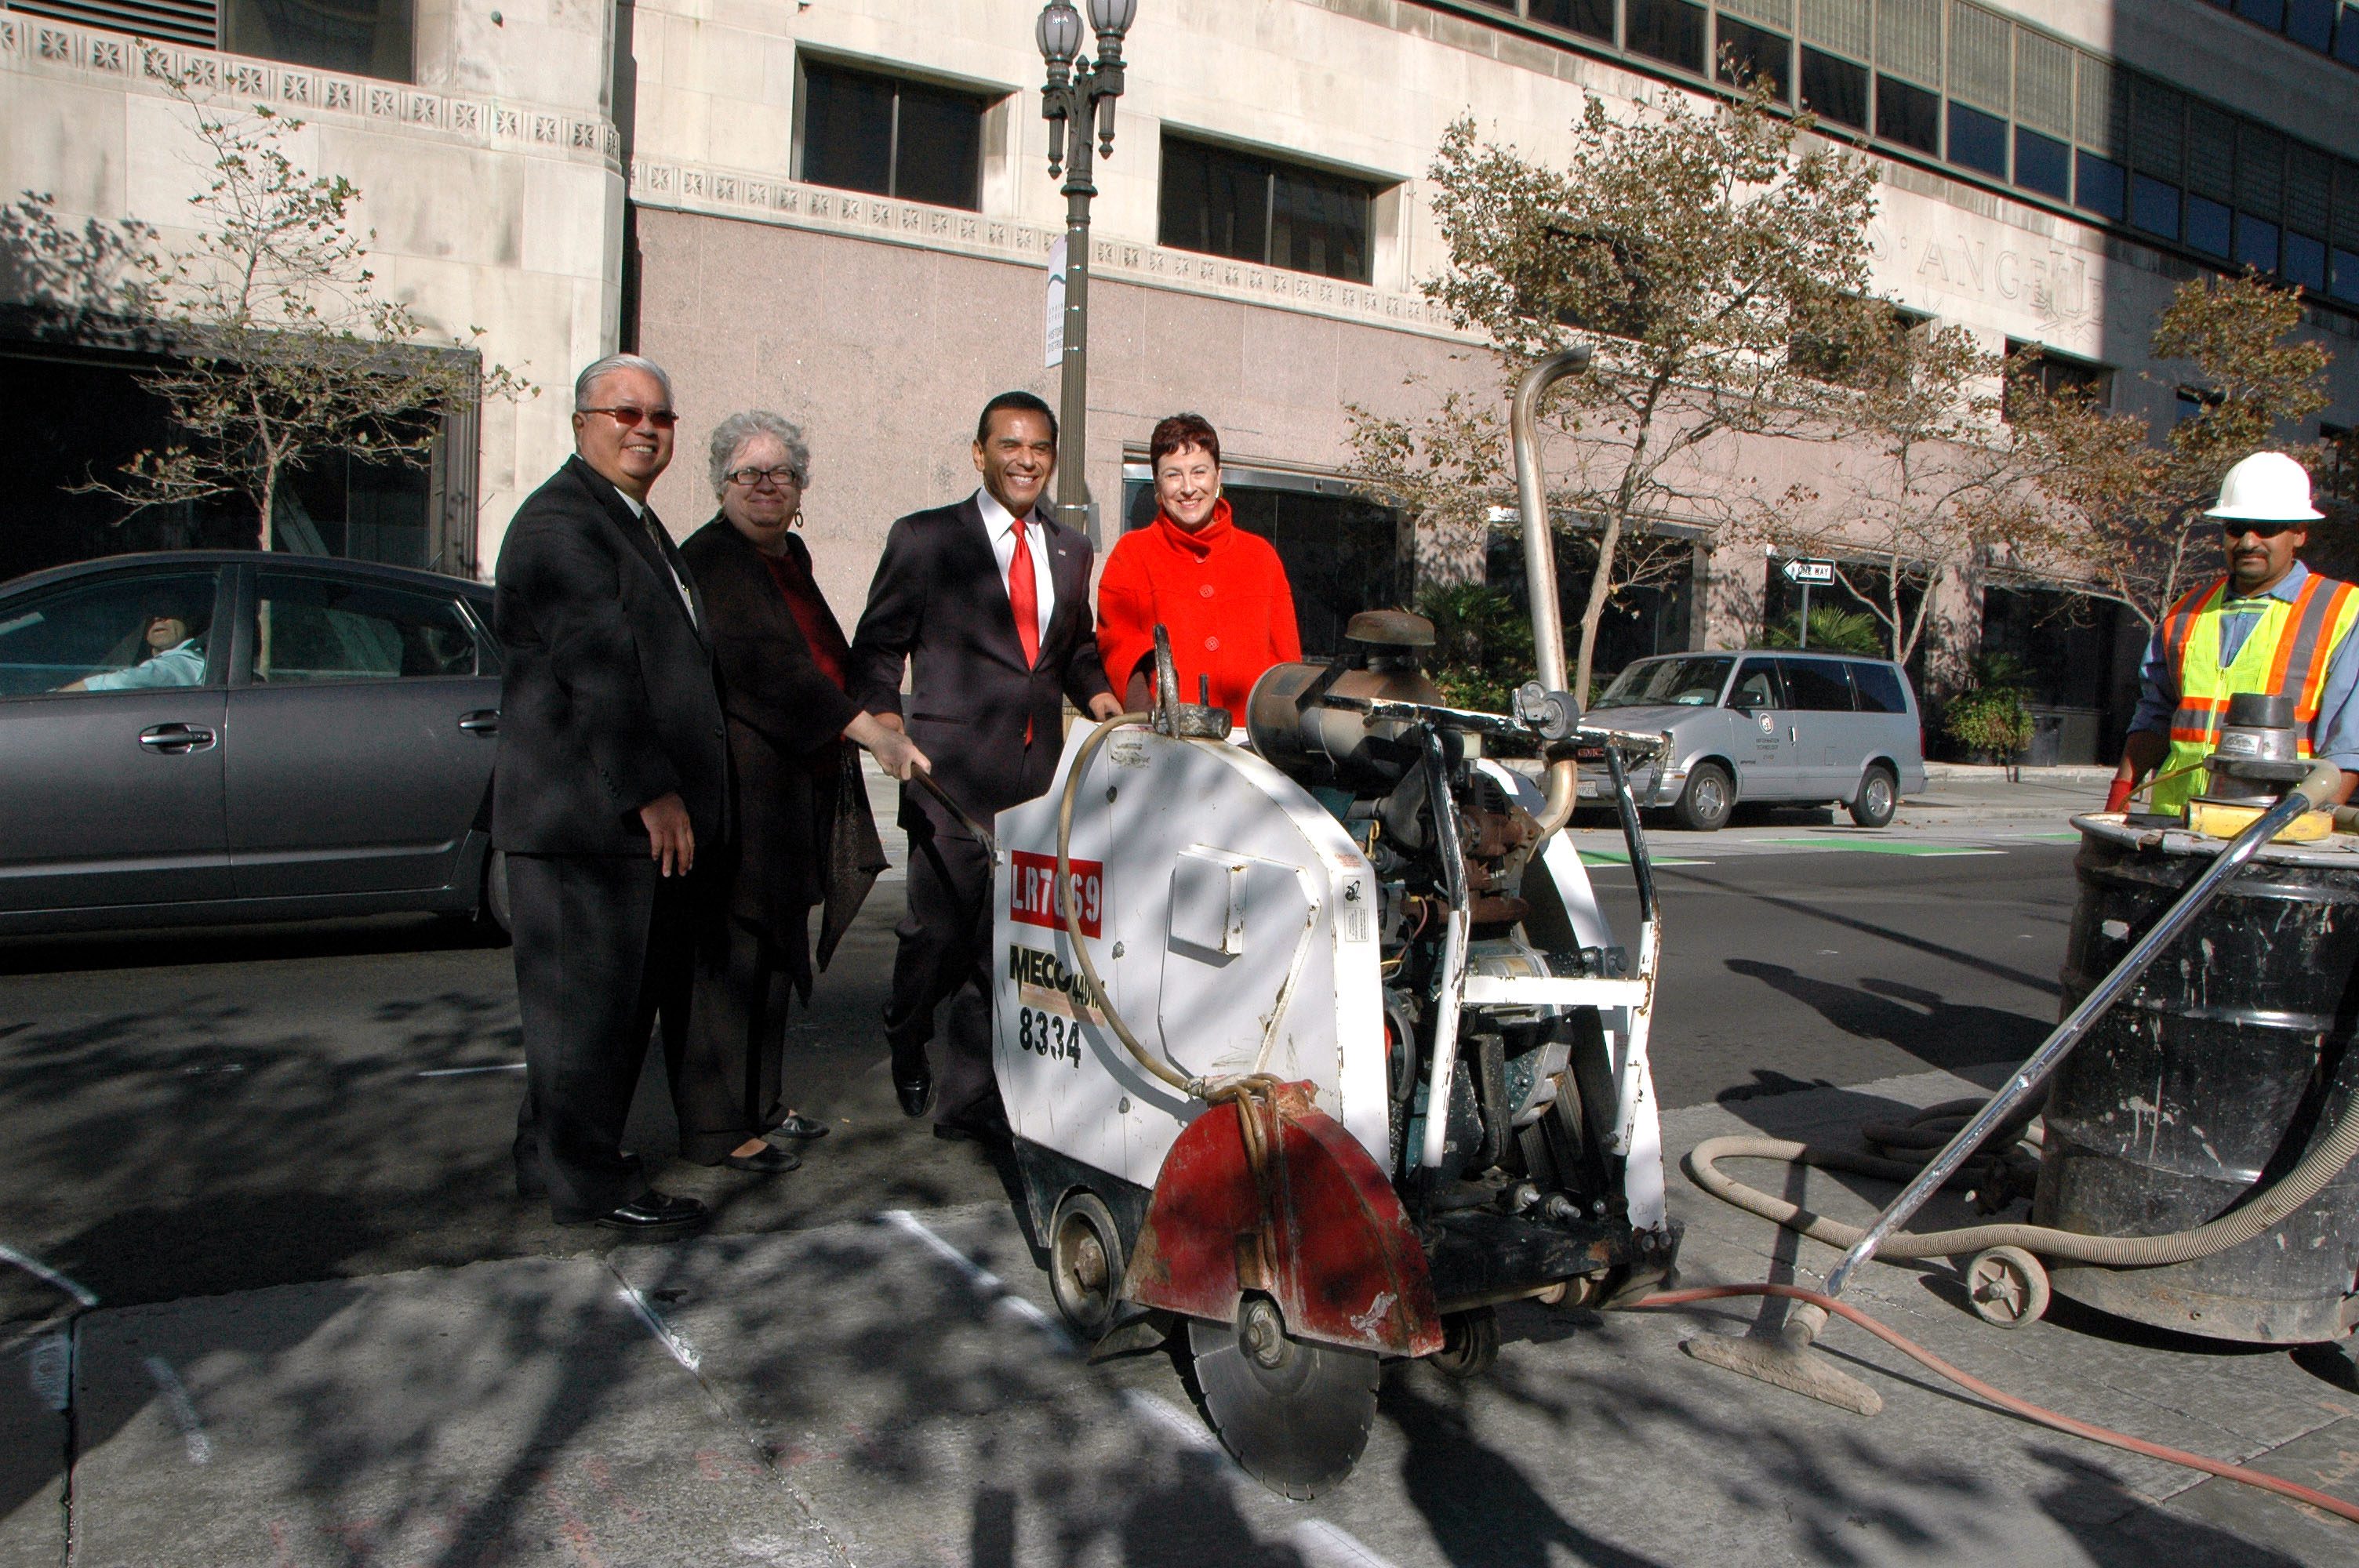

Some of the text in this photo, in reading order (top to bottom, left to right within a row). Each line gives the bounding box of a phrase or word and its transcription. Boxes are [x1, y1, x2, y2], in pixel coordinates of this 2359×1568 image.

[1798, 564, 1829, 576] ONE WAY
[1578, 748, 1605, 758] GMC
[1009, 945, 1073, 1002] MECO
[1020, 1006, 1081, 1069] 8334
